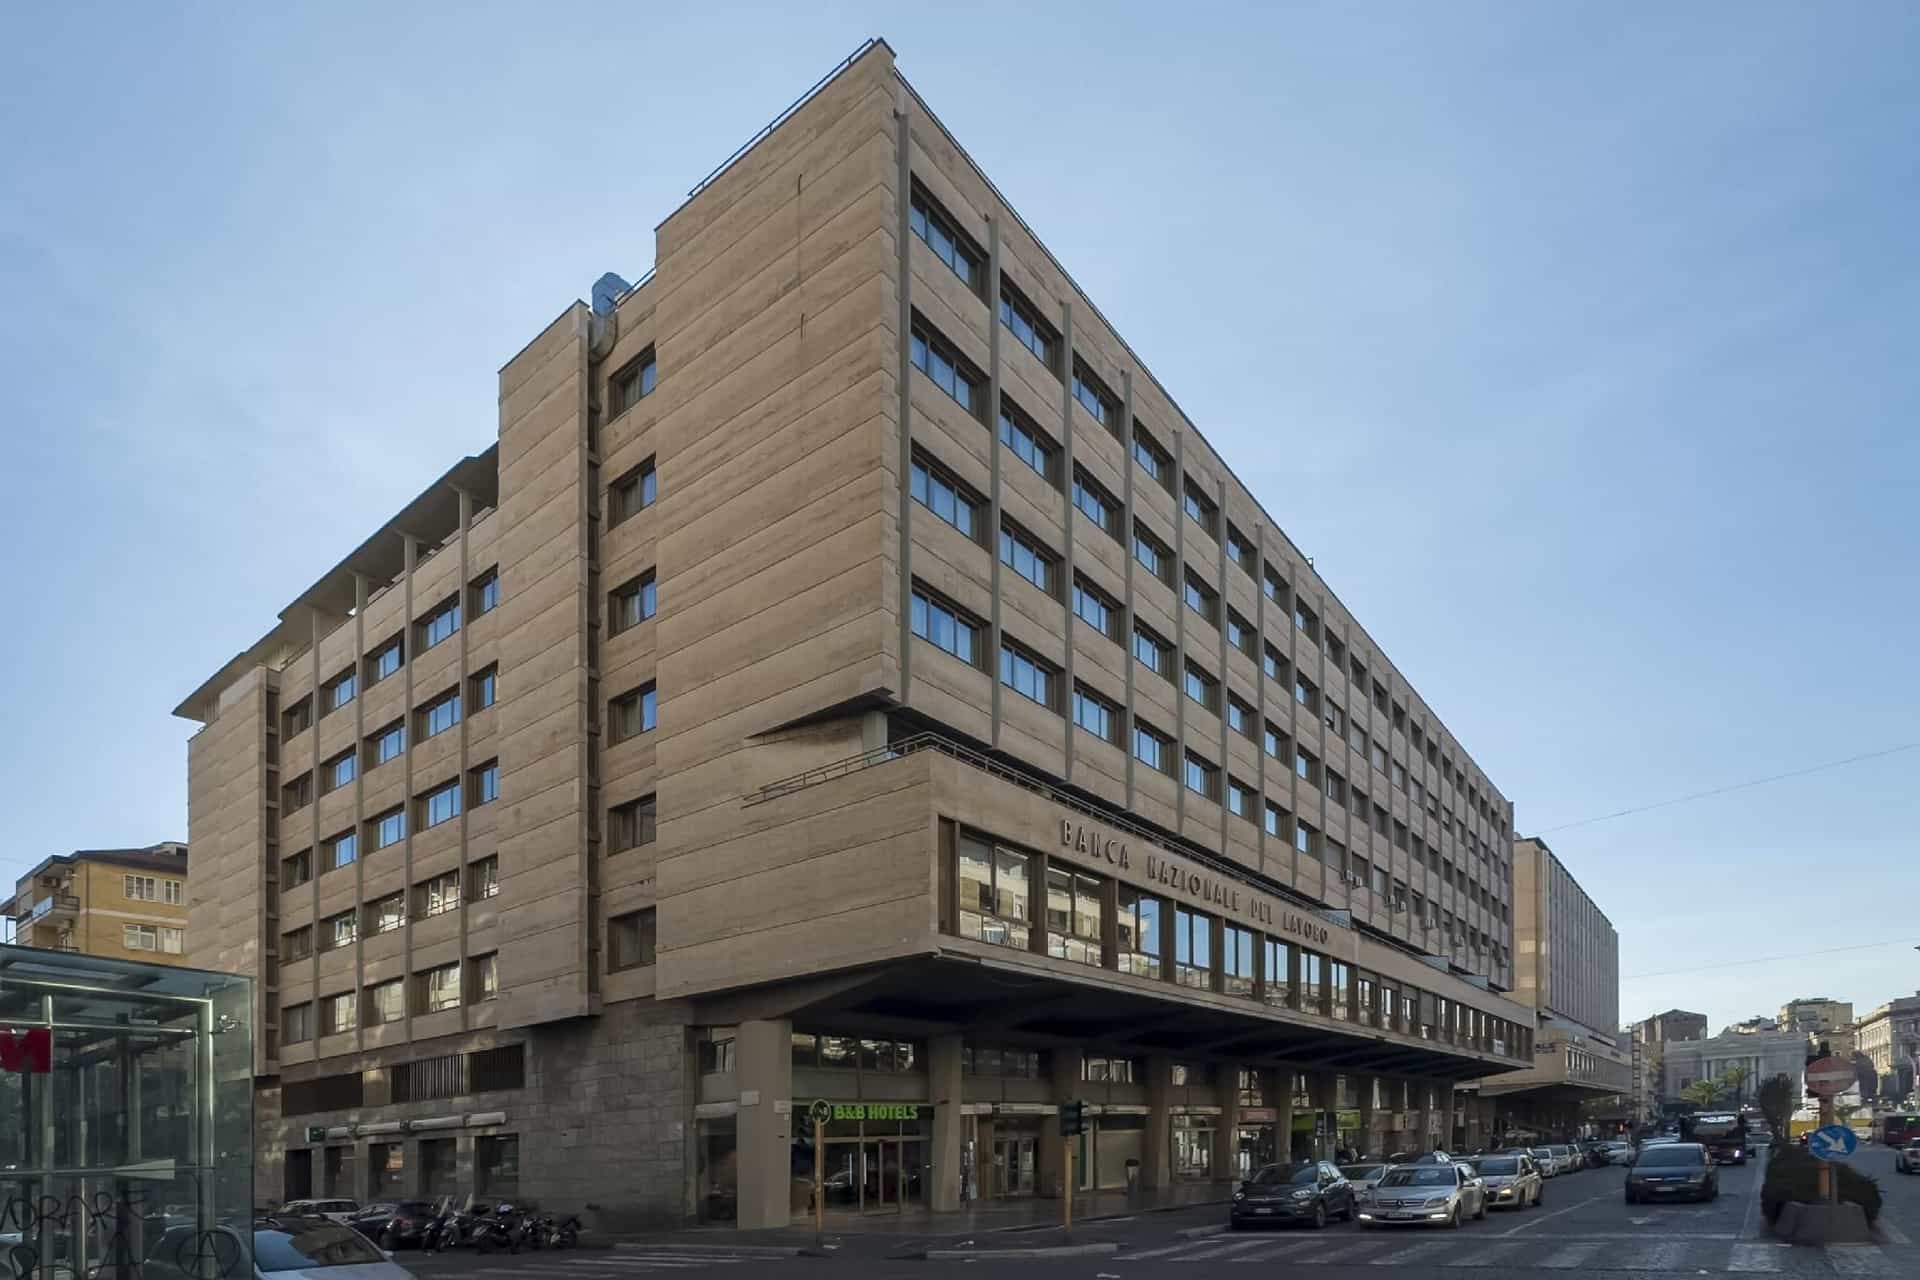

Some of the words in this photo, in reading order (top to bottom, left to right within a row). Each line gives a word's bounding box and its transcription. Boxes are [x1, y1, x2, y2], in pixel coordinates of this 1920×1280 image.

[1062, 819, 1129, 870] BANCA
[1147, 856, 1240, 911] NAZIONALE
[1250, 896, 1273, 925] DEL
[1283, 911, 1328, 944] LAVORO
[833, 1104, 866, 1120] B&B
[867, 1104, 918, 1120] HOTELS
